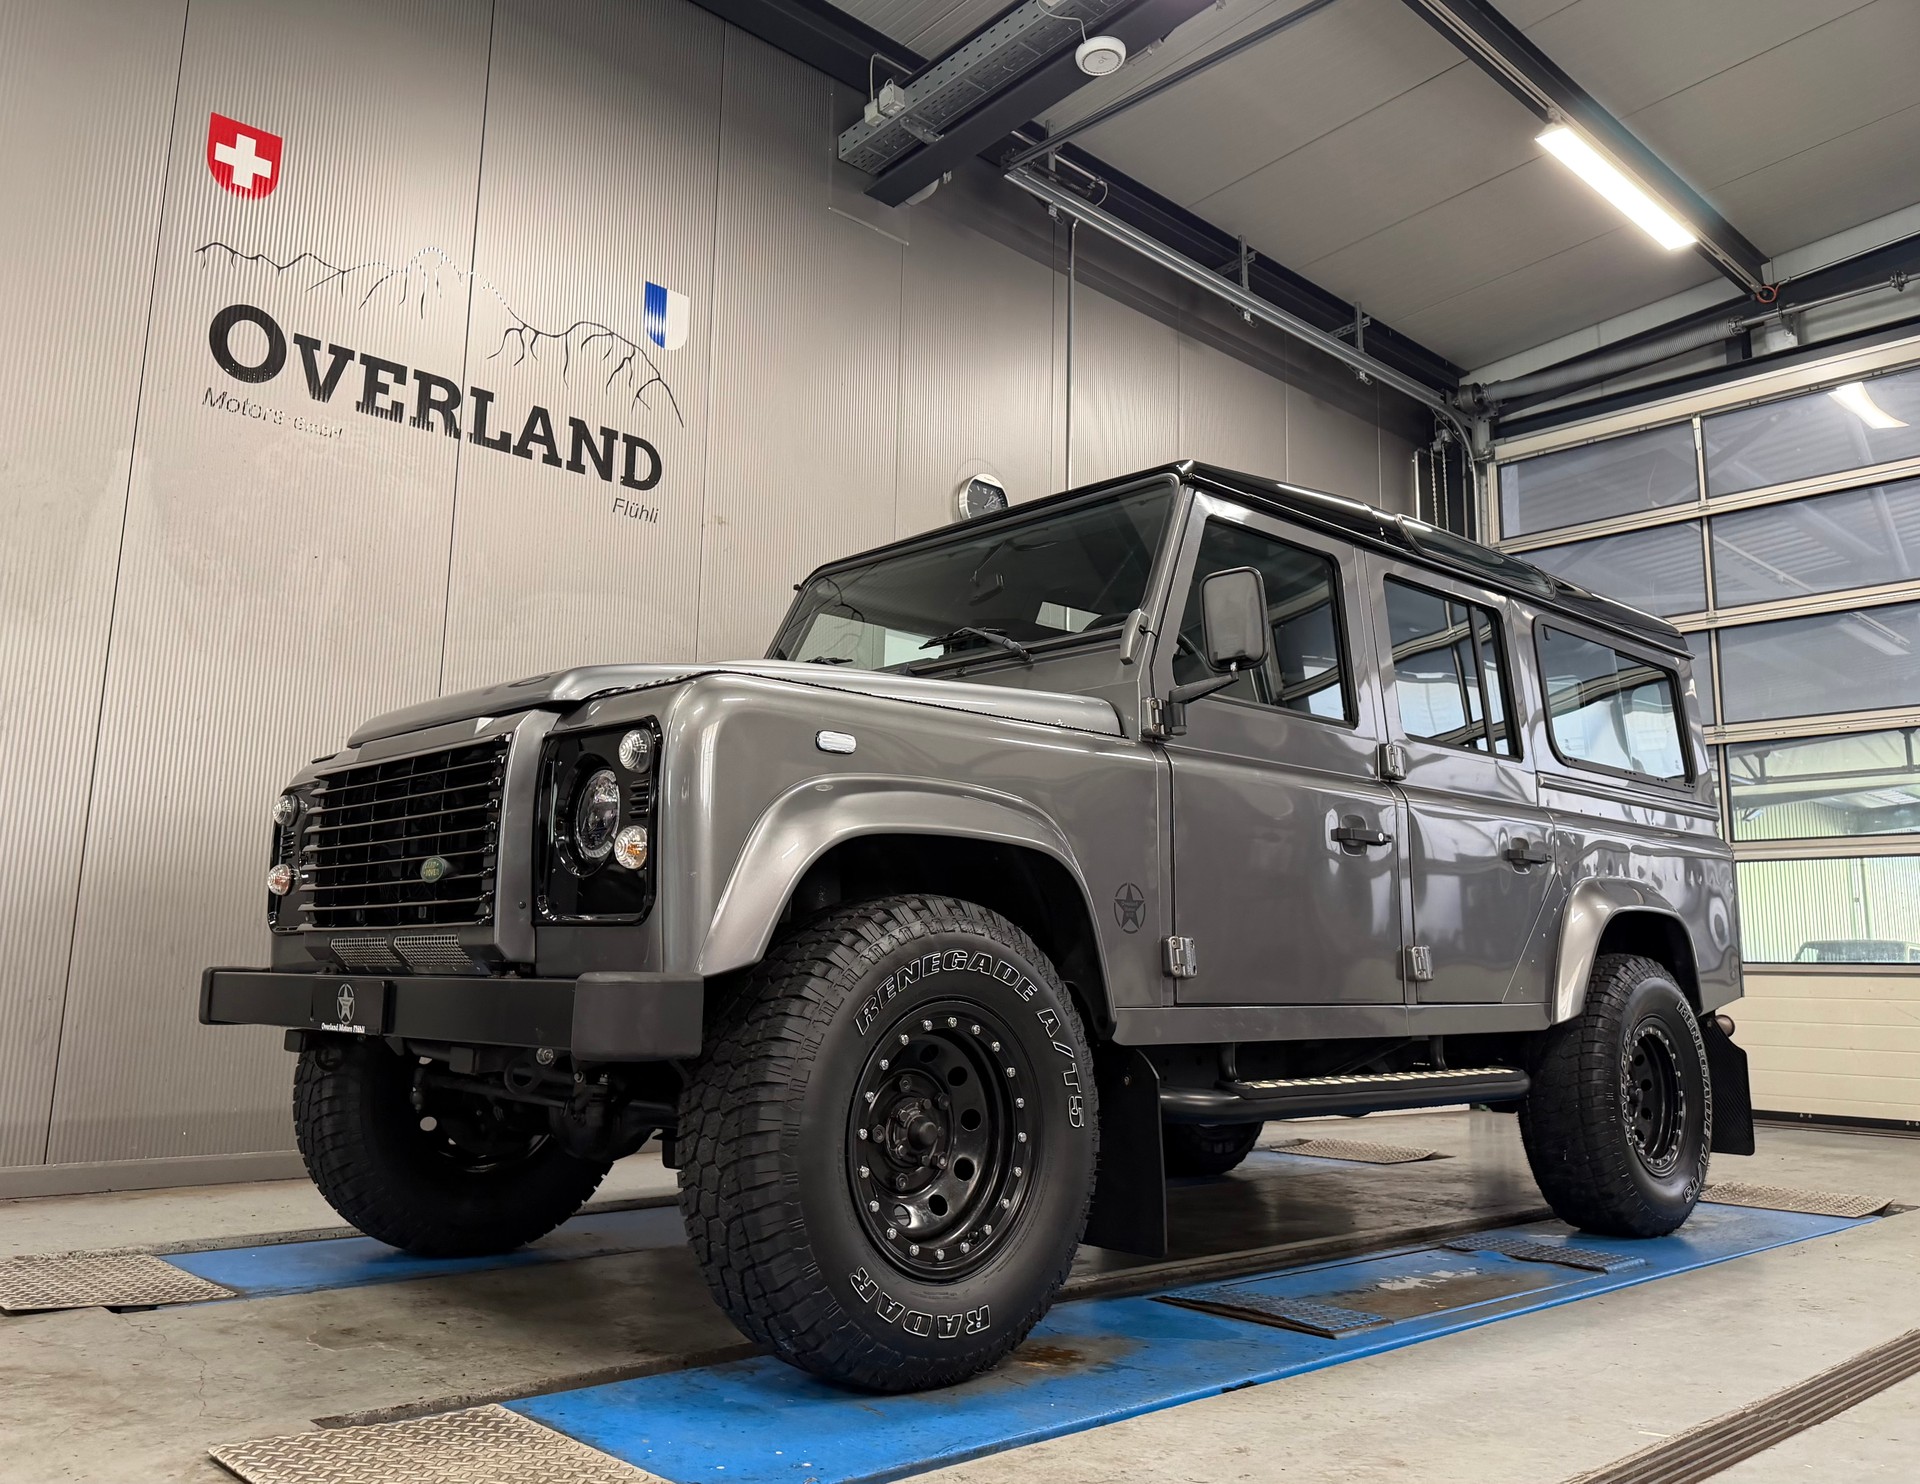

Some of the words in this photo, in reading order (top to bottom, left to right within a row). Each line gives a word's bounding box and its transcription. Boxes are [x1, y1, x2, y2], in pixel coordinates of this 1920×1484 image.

[202, 386, 285, 425] Motors
[209, 303, 663, 491] OVERLAND
[612, 497, 659, 523] Flühli
[853, 949, 1038, 1036] RENEGADE
[849, 1266, 992, 1339] RADAR
